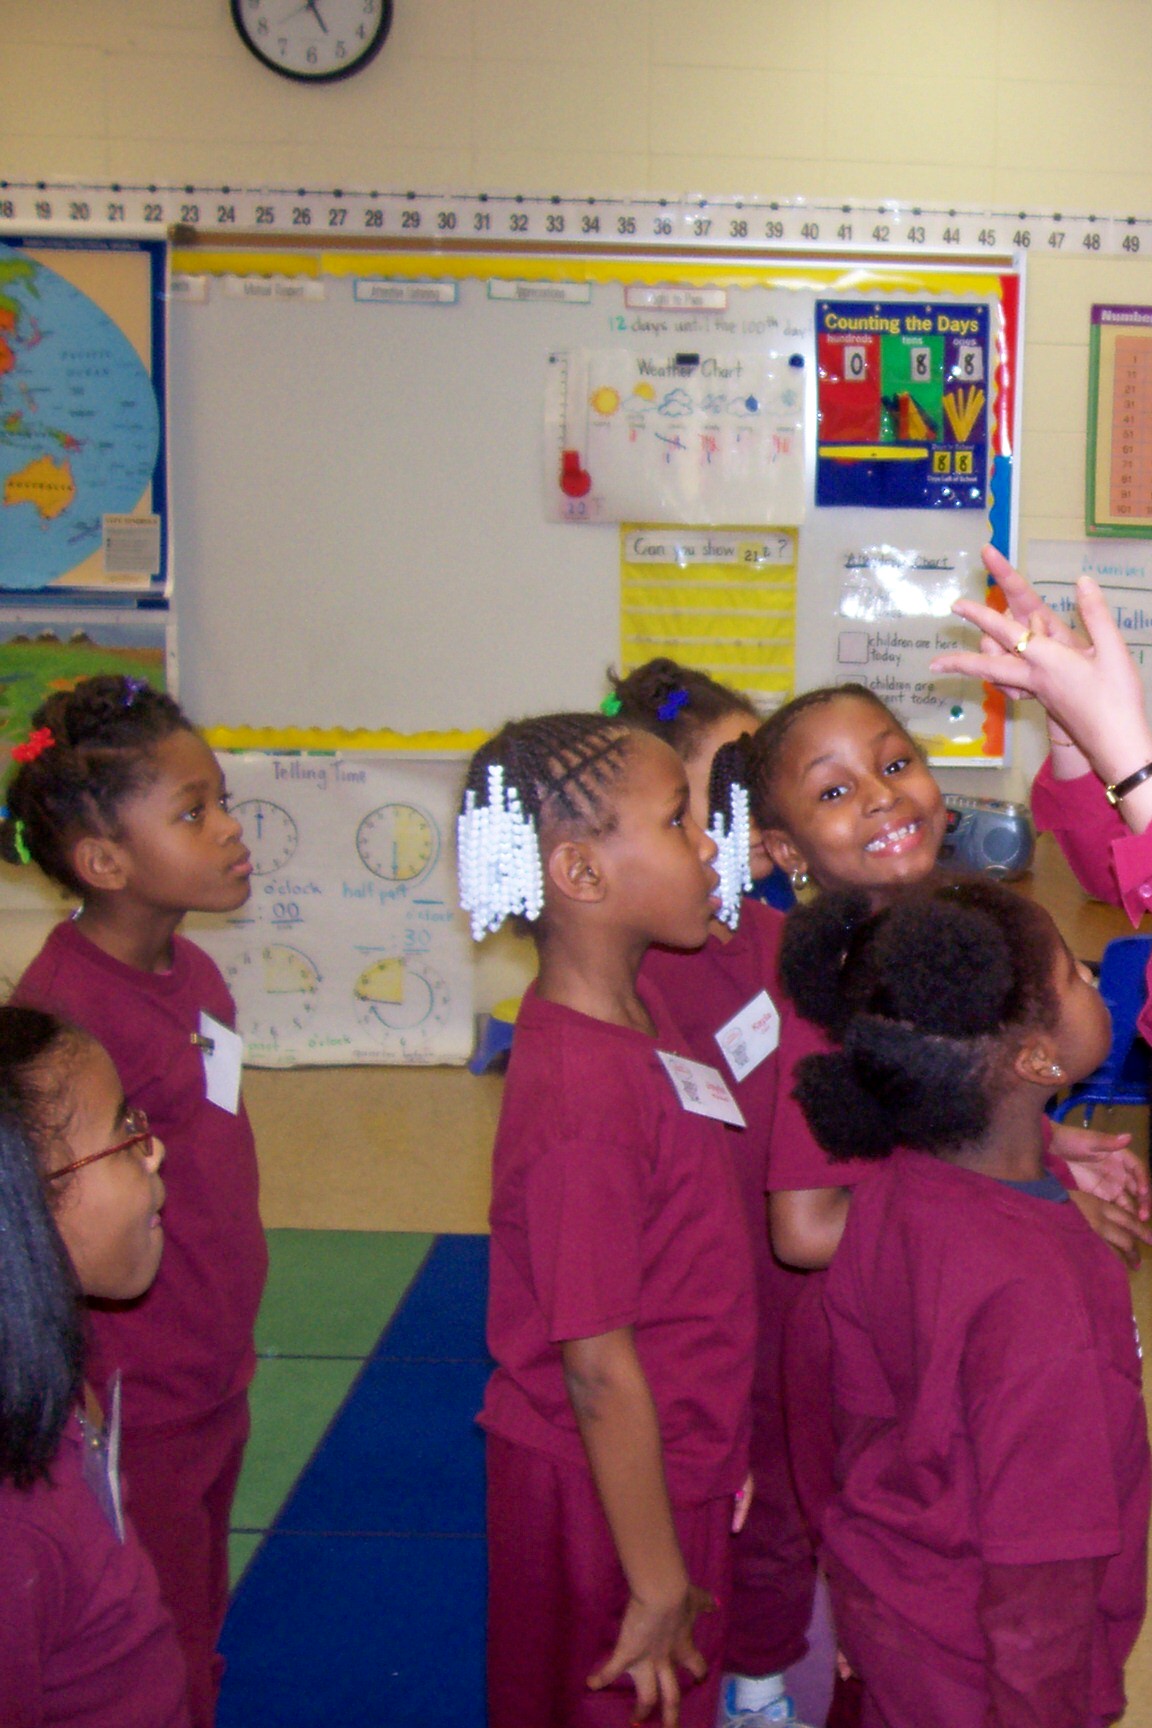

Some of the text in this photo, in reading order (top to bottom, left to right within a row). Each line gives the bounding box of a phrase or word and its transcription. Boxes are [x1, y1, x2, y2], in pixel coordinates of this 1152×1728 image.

[306, 46, 317, 64] 6
[35, 202, 50, 219] 19
[70, 202, 89, 220] 20
[107, 203, 124, 221] 21
[144, 204, 162, 222] 22
[181, 205, 199, 222] 23
[217, 206, 235, 223] 24
[255, 206, 274, 224] 25
[292, 207, 311, 225] 26
[329, 208, 347, 226] 27
[365, 209, 383, 228] 28
[402, 210, 421, 228] 29
[437, 212, 456, 229] 30
[474, 213, 491, 230] 31
[509, 213, 528, 232] 32
[546, 214, 564, 232] 33
[581, 216, 599, 233] 34
[617, 216, 636, 234] 35
[653, 218, 671, 235] 36
[693, 219, 712, 236] 37
[729, 220, 748, 238] 38
[765, 221, 783, 238] 39
[801, 222, 819, 240] 40
[837, 223, 853, 240] 41
[872, 225, 890, 242] 42
[907, 226, 925, 244] 43
[943, 227, 960, 245] 44
[978, 228, 996, 246] 45
[1012, 230, 1031, 248] 46
[1048, 231, 1066, 249] 47
[1082, 233, 1100, 251] 48
[1122, 234, 1140, 252] 49
[824, 312, 979, 336] Counting the Days
[700, 357, 744, 379] Chart
[916, 353, 928, 376] 8
[963, 353, 975, 376] 8
[937, 453, 970, 472] 8 8
[7, 480, 74, 493] AUSTRALIA
[634, 537, 666, 559] Can
[702, 539, 735, 558] show
[935, 632, 958, 649] here
[870, 674, 912, 691] children
[273, 759, 367, 790] Telling Time
